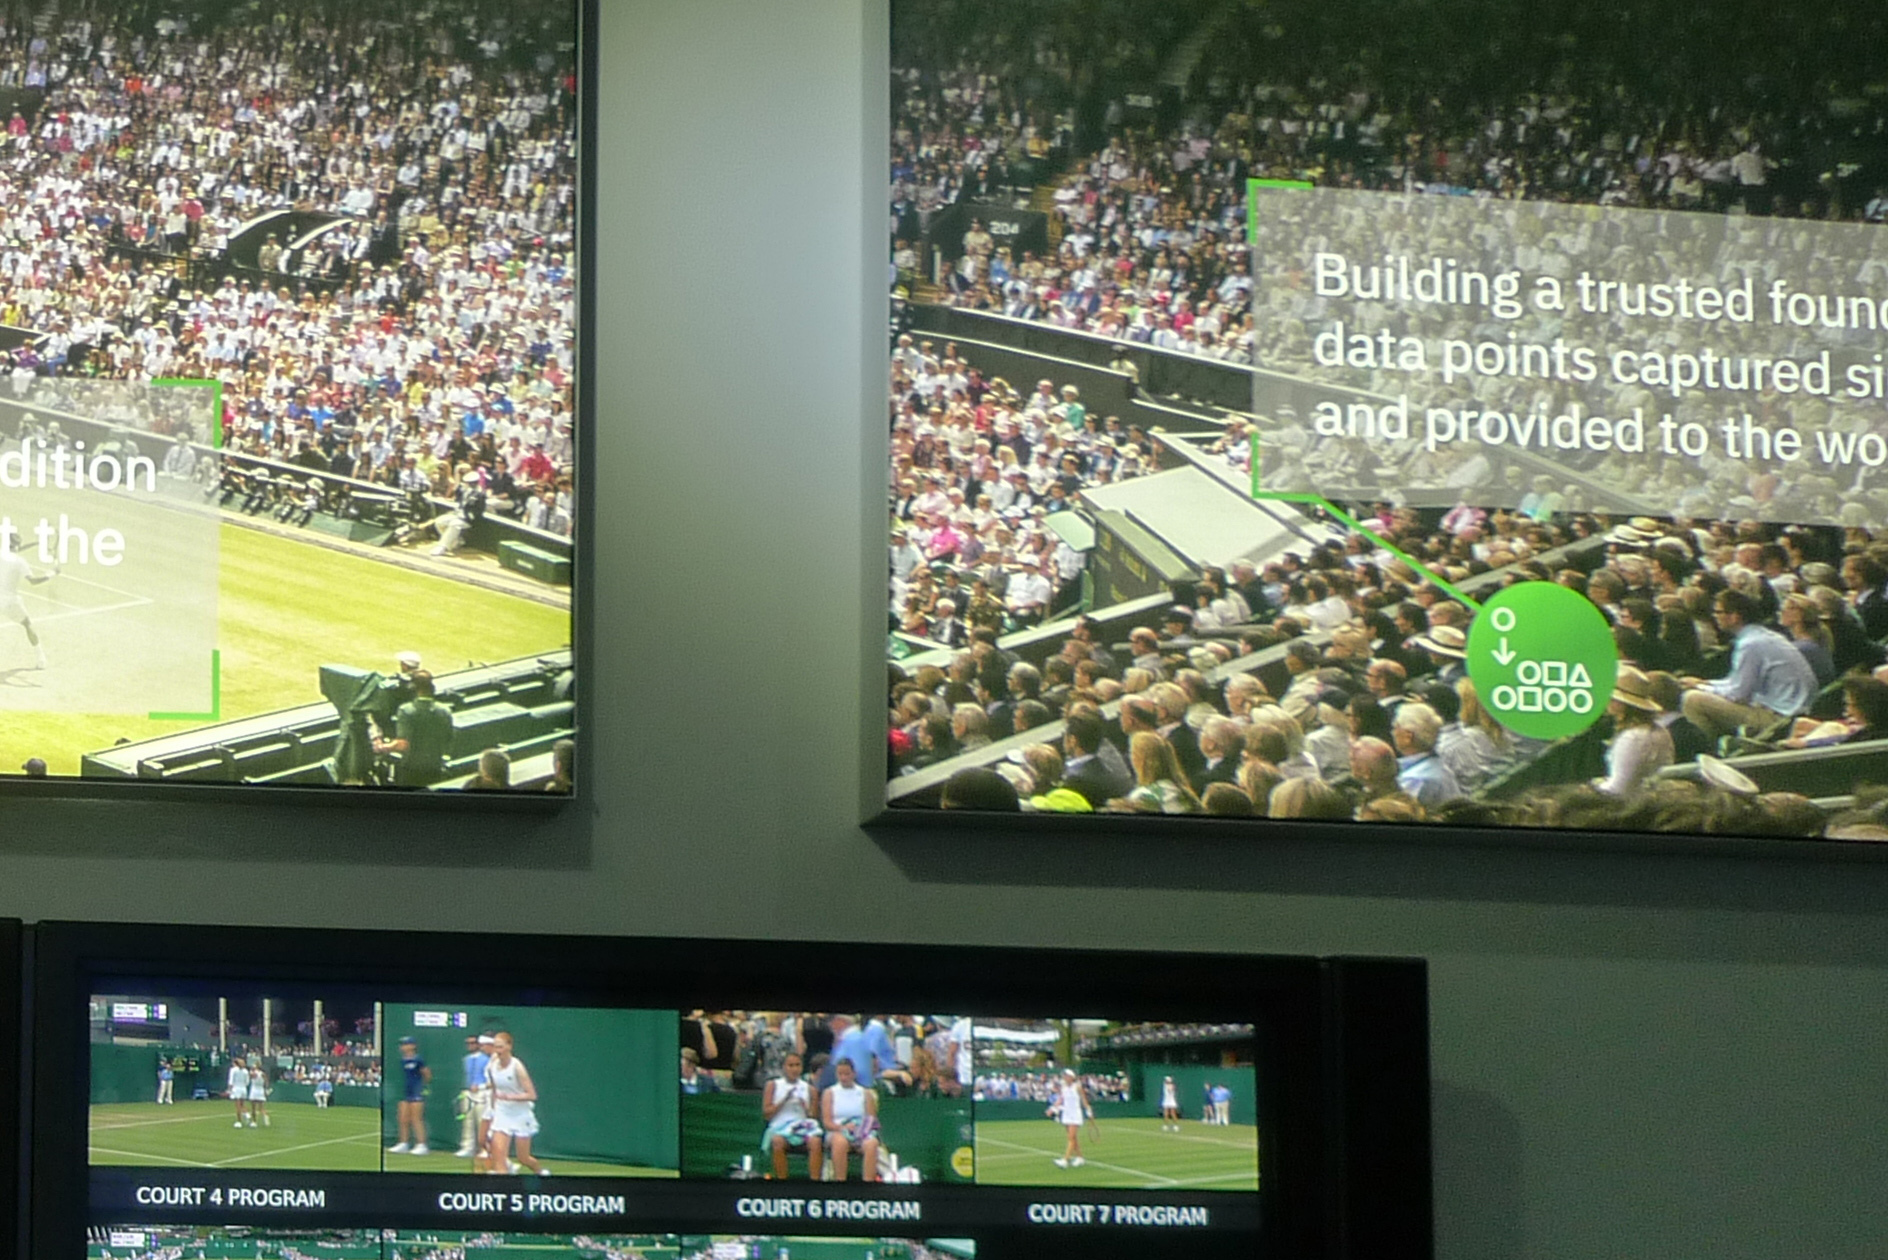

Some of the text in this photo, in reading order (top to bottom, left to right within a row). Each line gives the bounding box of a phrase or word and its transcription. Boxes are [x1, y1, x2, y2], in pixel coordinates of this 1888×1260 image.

[1315, 252, 1523, 320] Building
[1534, 274, 1564, 312] a
[1576, 270, 1754, 323] trusted
[1314, 321, 1427, 372] data
[1443, 332, 1598, 384] points
[1610, 345, 1831, 400] captured
[1315, 395, 1409, 440] and
[1426, 402, 1645, 455] provided
[1659, 412, 1709, 457] to
[1722, 414, 1803, 462] the
[34, 513, 126, 567] the
[136, 1186, 325, 1208] COURT 4 PROGRAM
[438, 1192, 625, 1214] COURT 5 PROGRAM
[736, 1197, 921, 1220] COURT 6 PROGRAM
[1028, 1203, 1208, 1226] COURT 7 PROGRAM
